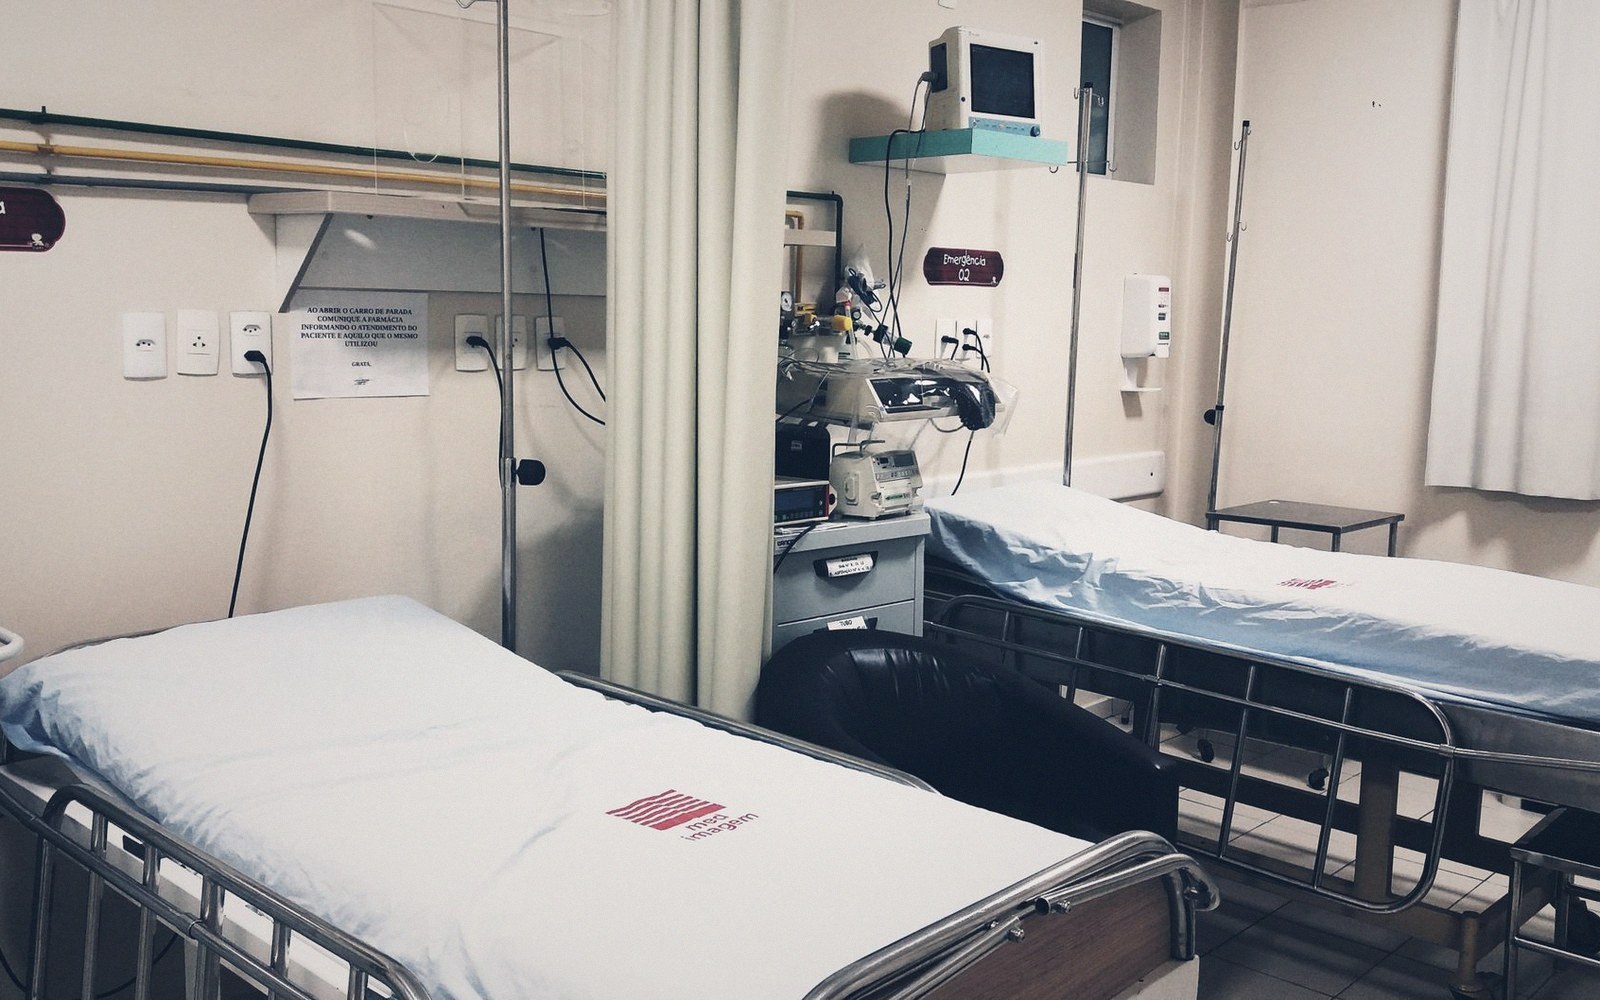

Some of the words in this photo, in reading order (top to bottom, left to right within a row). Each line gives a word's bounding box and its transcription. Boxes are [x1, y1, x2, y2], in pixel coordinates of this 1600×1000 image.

[943, 253, 986, 267] Emergência
[958, 268, 970, 282] 02
[349, 307, 374, 315] CARRO
[343, 332, 371, 340] AQUILO
[680, 813, 759, 841] imagem
[685, 814, 730, 831] med
